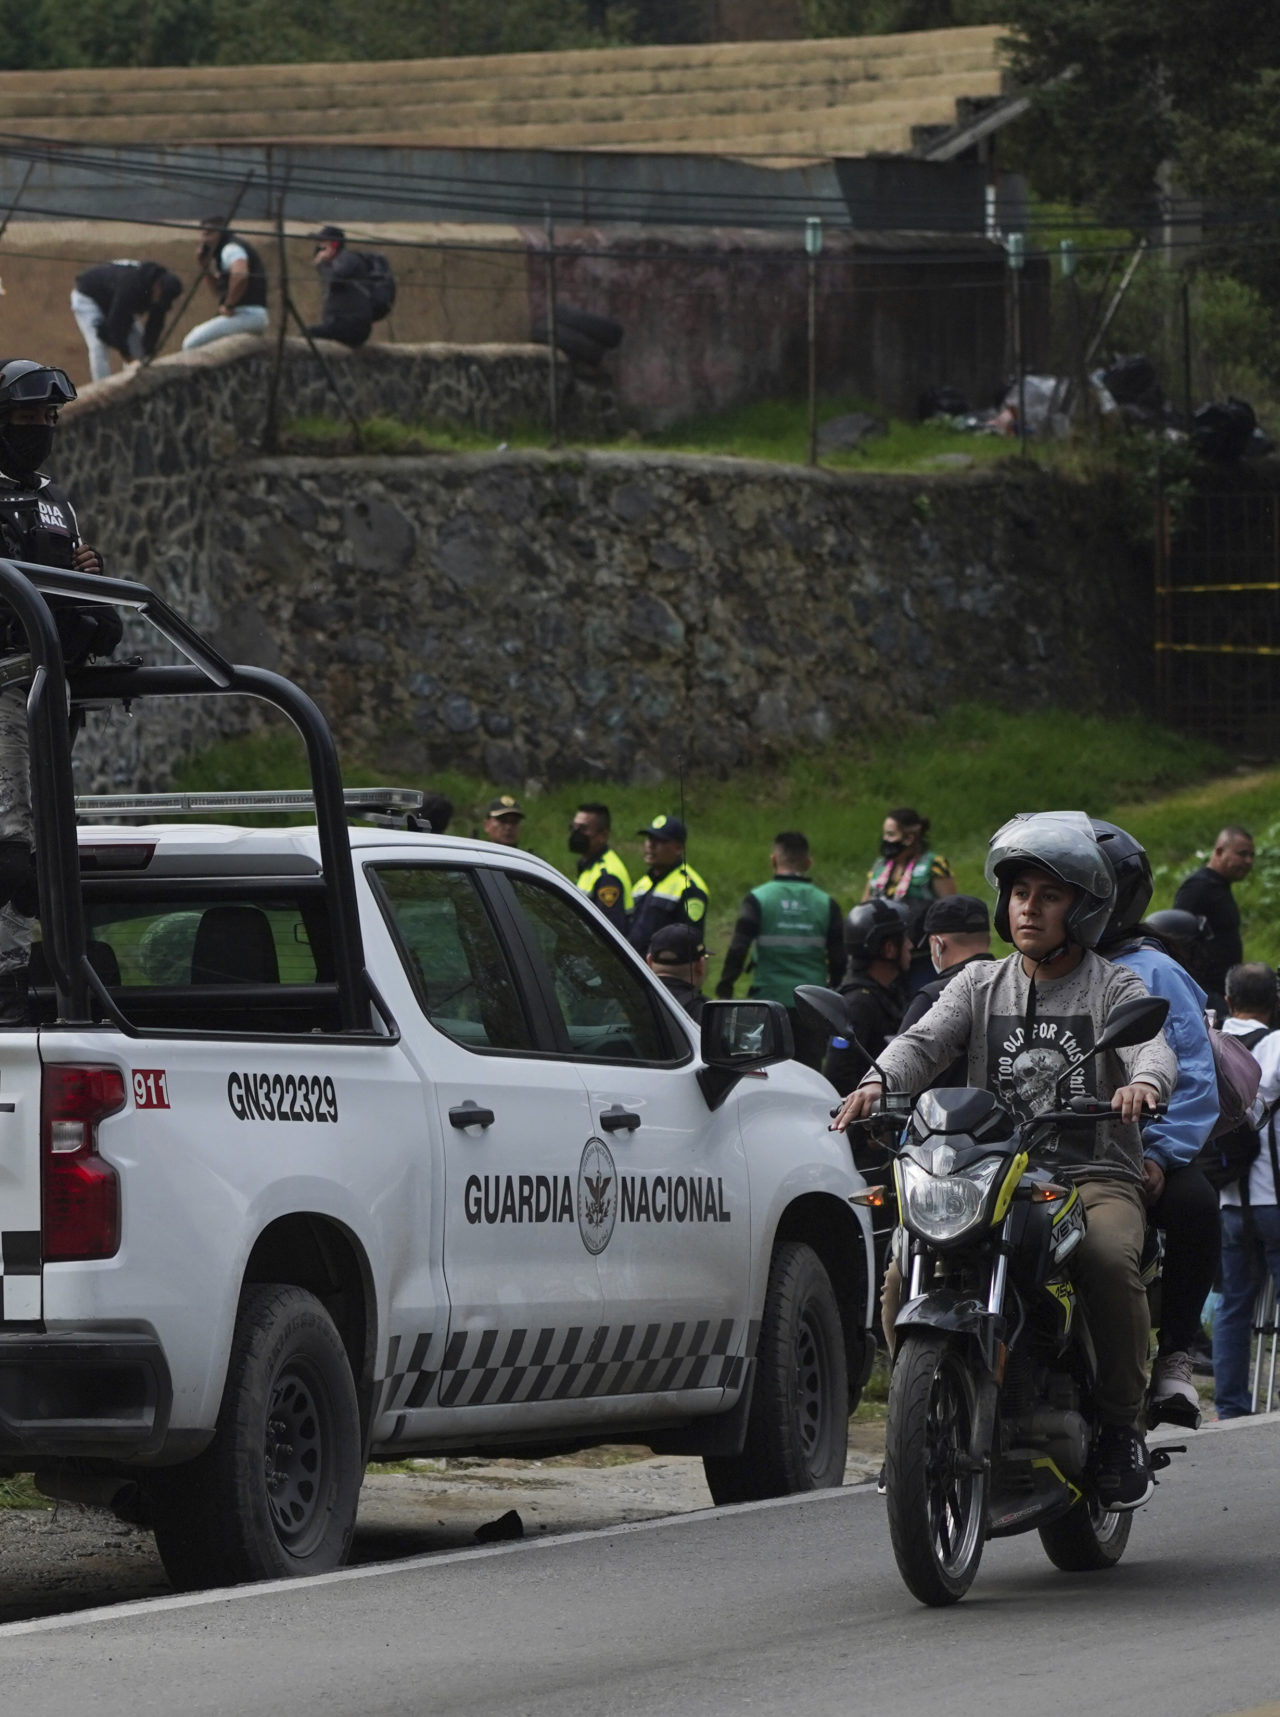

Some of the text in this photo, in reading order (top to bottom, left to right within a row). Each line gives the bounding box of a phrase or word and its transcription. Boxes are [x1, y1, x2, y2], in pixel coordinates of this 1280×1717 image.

[133, 1073, 169, 1106] 911
[227, 1071, 339, 1124] GN322329
[464, 1174, 731, 1225] GUARDIA NACIONAL
